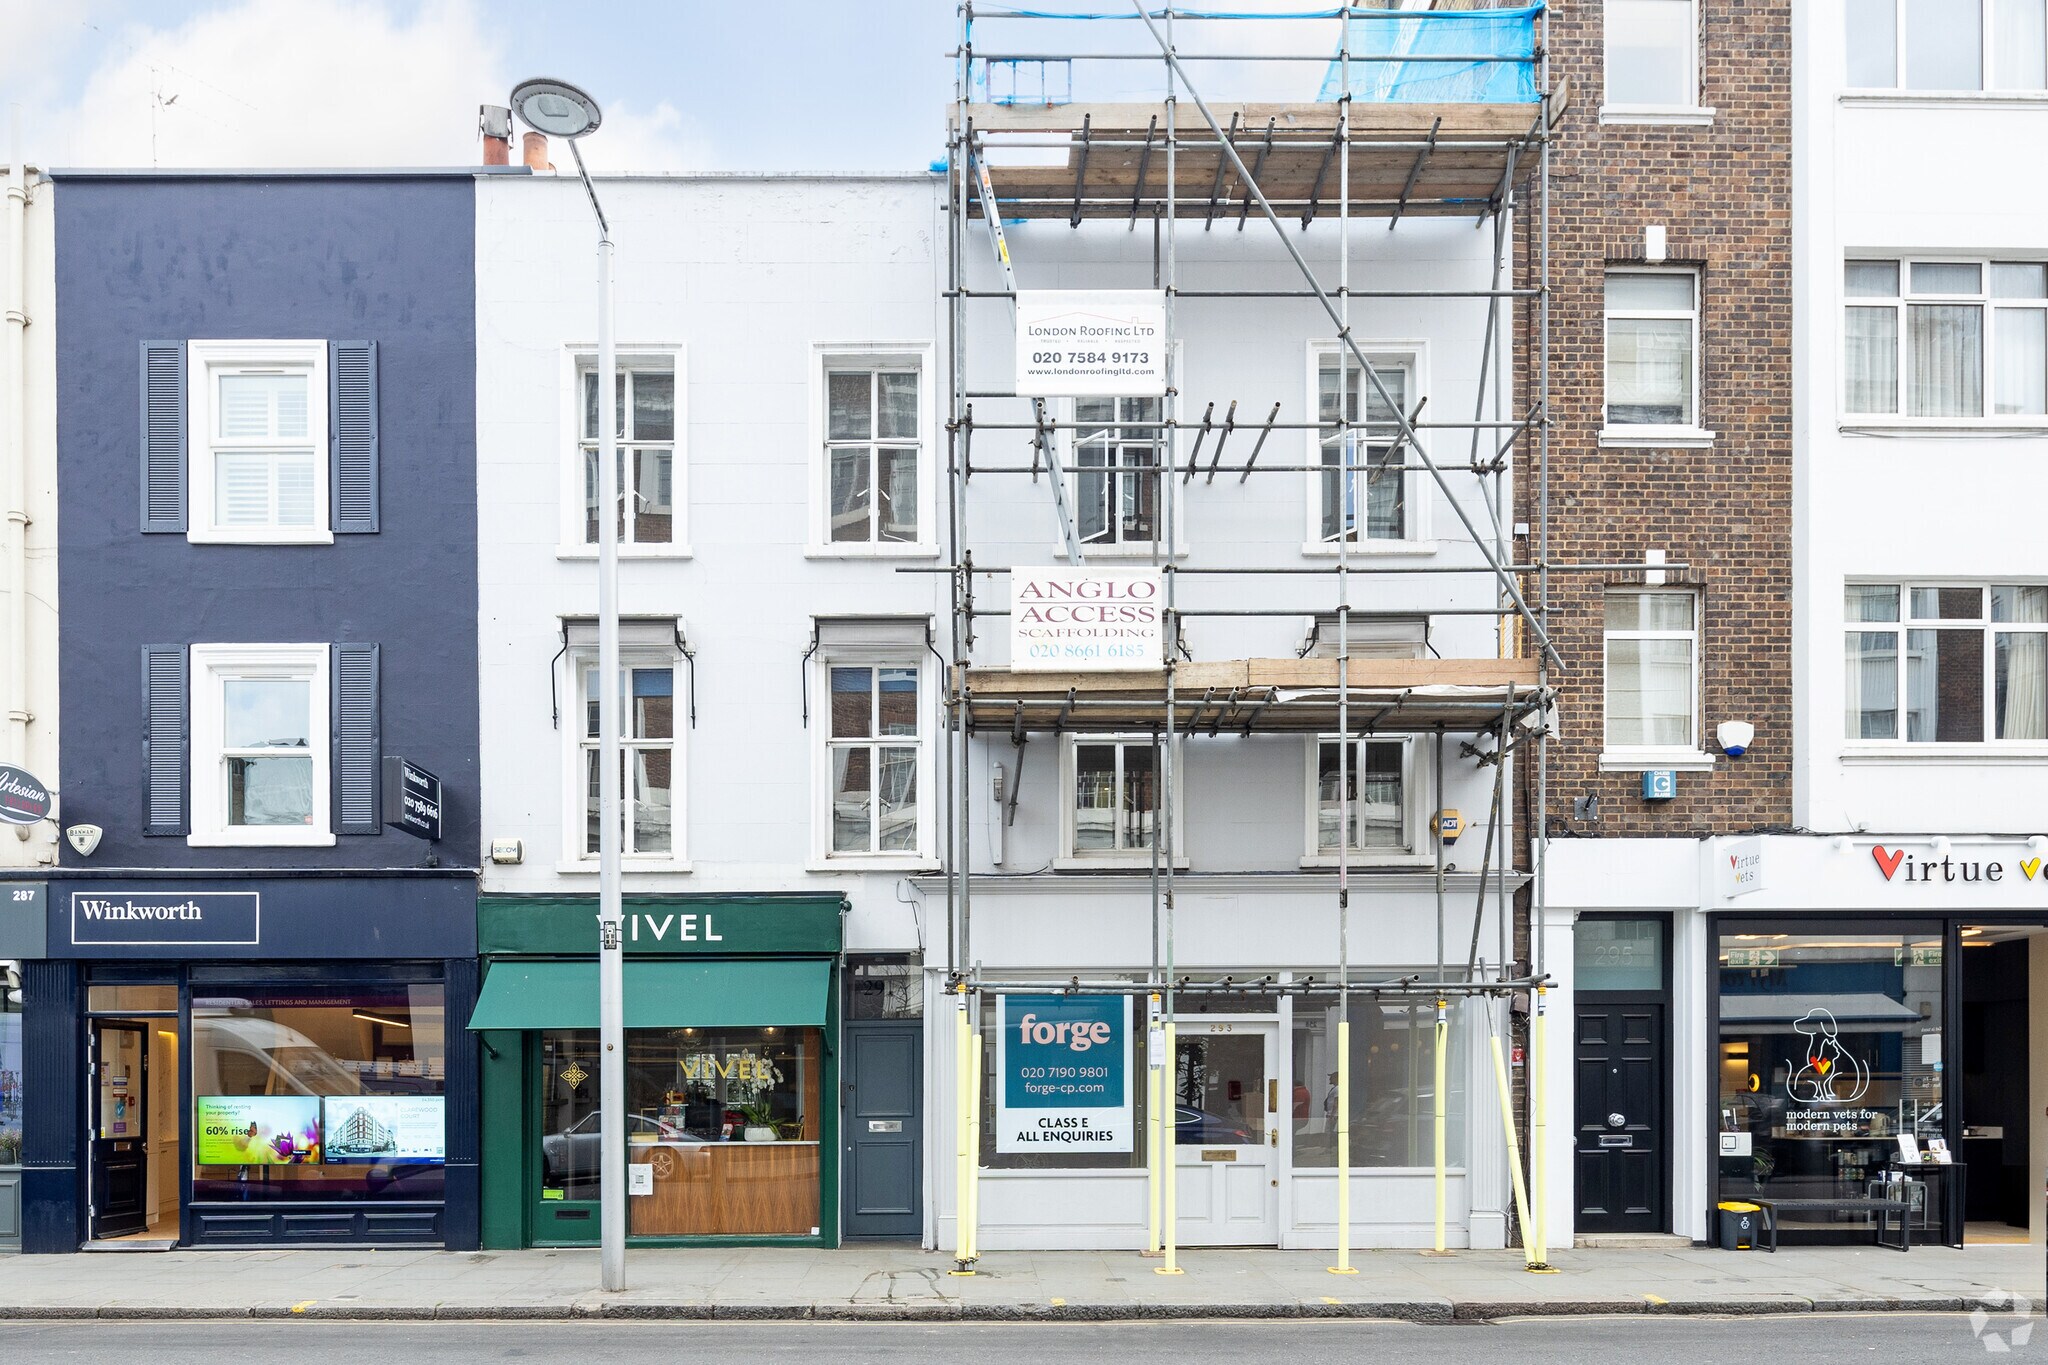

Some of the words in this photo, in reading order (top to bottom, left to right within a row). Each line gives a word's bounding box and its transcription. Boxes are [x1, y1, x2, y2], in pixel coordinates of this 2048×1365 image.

[1032, 352, 1062, 364] 020
[1067, 352, 1106, 364] 7584
[1111, 352, 1149, 364] 9173
[1027, 367, 1155, 377] www.londonroofingltd.com
[1019, 581, 1156, 599] ANGLO
[1019, 605, 1156, 624] ACCESS
[1018, 627, 1154, 638] SCAFFOLDING
[1029, 643, 1059, 658] 020
[1064, 643, 1100, 658] 8661
[1107, 643, 1145, 658] 6185
[403, 766, 429, 789] Winkworth
[403, 796, 415, 808] 020
[1442, 819, 1458, 828] ADT
[1729, 854, 1760, 870] Virtue
[1871, 844, 2004, 882] Virtue
[2019, 856, 2048, 882] v
[12, 890, 36, 902] 287
[80, 900, 203, 920] Winkworth
[595, 913, 723, 942] IVEL
[1594, 945, 1634, 966] 295
[245, 999, 265, 1007] SALES,
[1019, 1013, 1111, 1052] forge
[1210, 1024, 1233, 1033] 293
[679, 1059, 769, 1080] VIVEL
[1021, 1067, 1046, 1079] 020
[1048, 1067, 1076, 1079] 7190
[1079, 1067, 1109, 1079] 9801
[1025, 1082, 1105, 1096] forge-cp.com
[1785, 1108, 1831, 1120] modern
[1832, 1109, 1858, 1120] vets
[1859, 1108, 1878, 1120] for
[1038, 1117, 1078, 1129] CLASS
[1081, 1117, 1089, 1129] E
[1785, 1120, 1831, 1131] modern
[1832, 1122, 1858, 1133] pets
[205, 1126, 229, 1136] 60%
[231, 1126, 249, 1136] rise
[1016, 1131, 1040, 1142] ALL
[1043, 1130, 1114, 1144] ENQUIRIES
